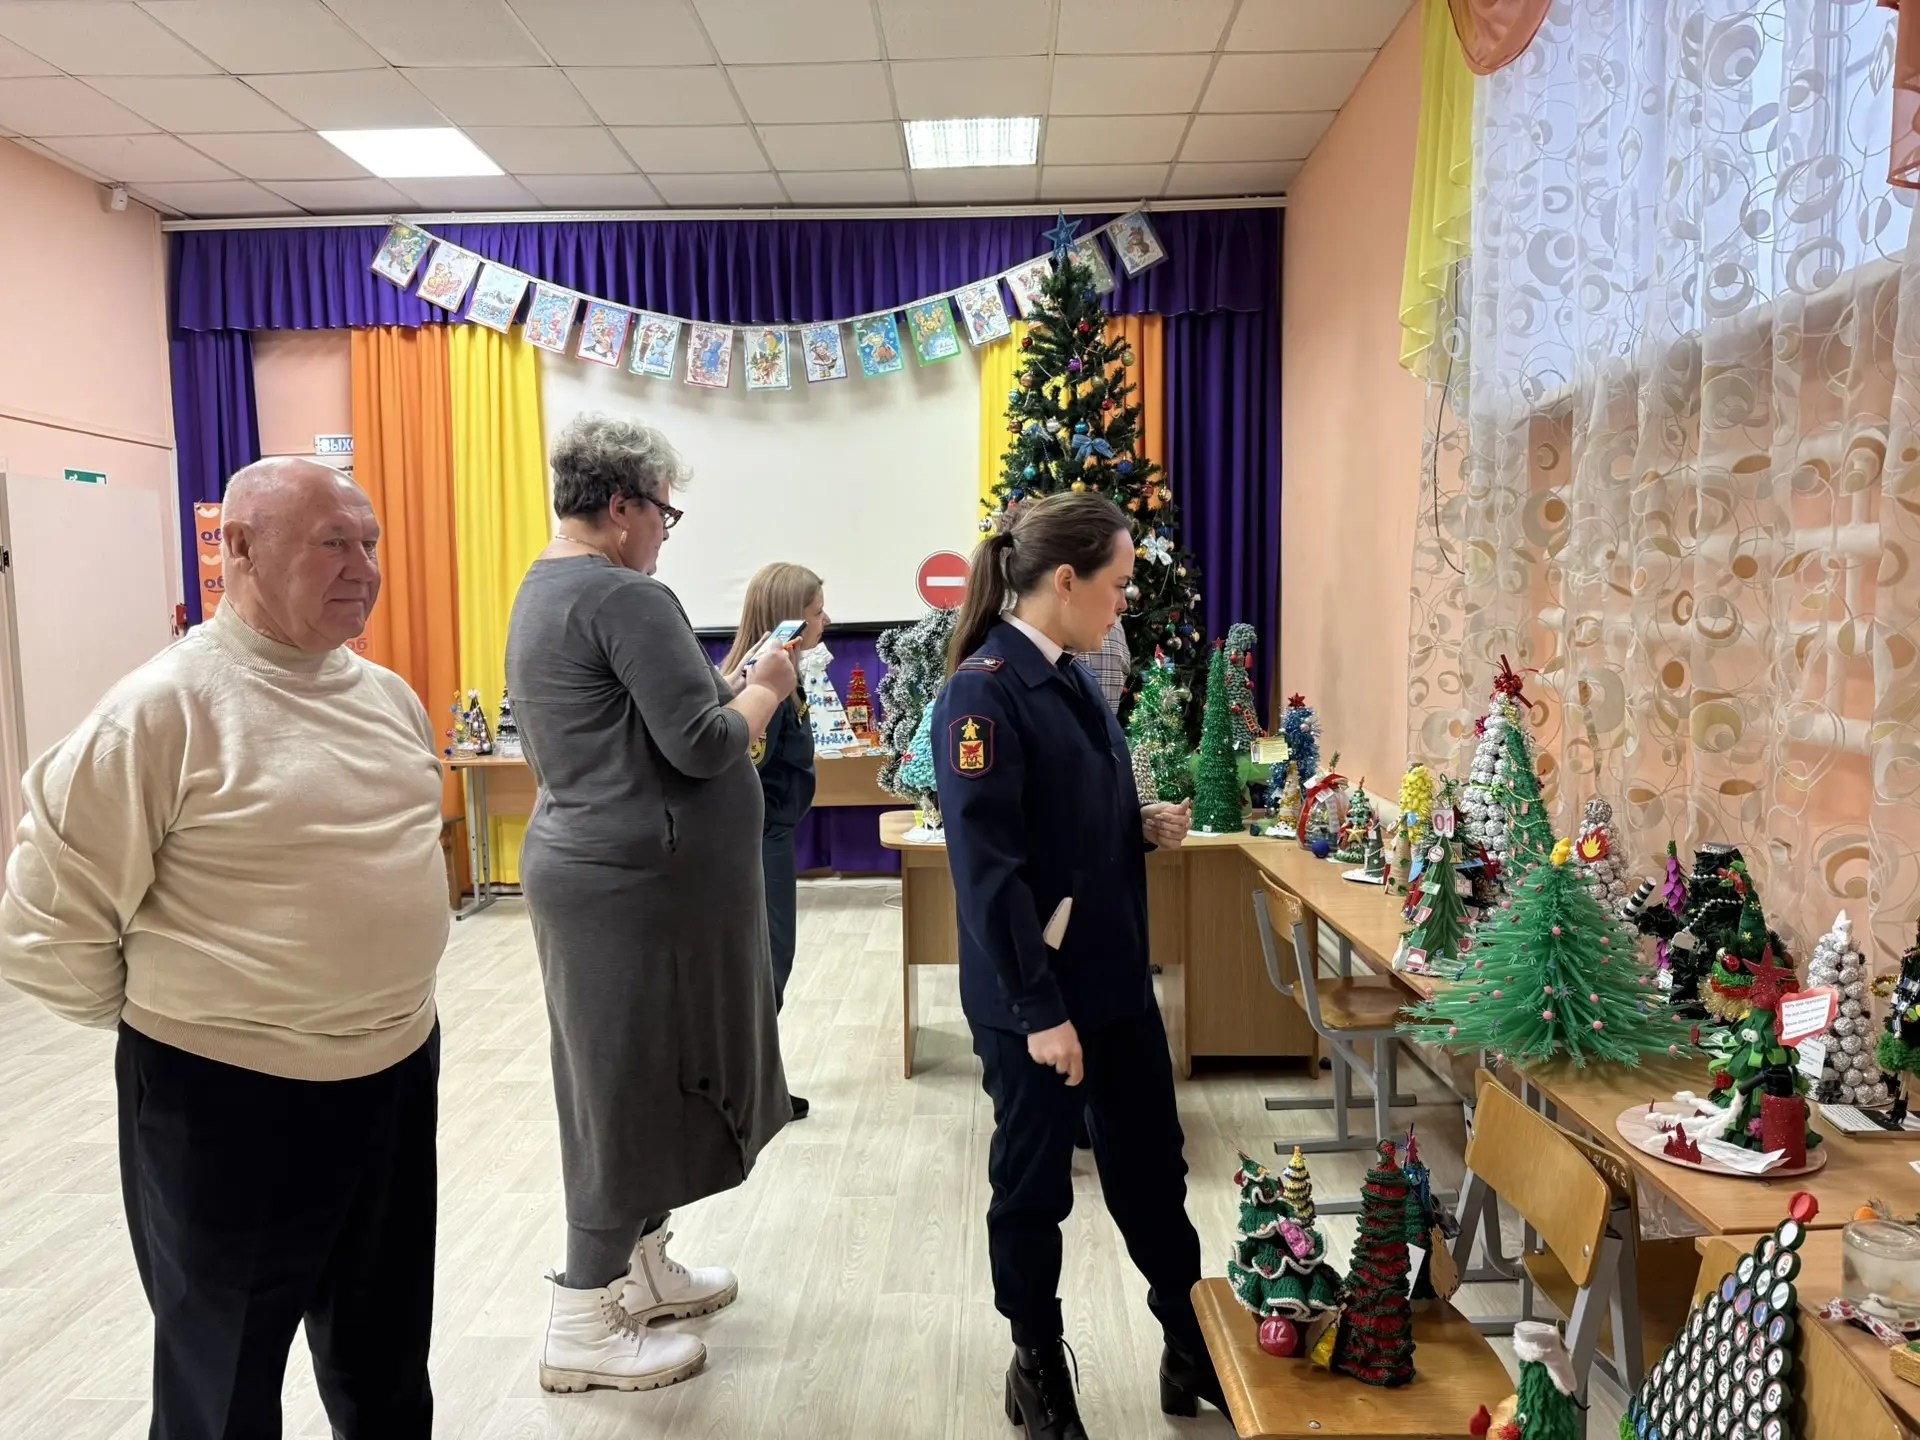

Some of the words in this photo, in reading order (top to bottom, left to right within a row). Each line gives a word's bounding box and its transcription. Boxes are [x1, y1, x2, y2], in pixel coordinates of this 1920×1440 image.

[320, 438, 354, 452] ВЫХ
[1434, 814, 1453, 832] 01
[1264, 1321, 1288, 1343] 12
